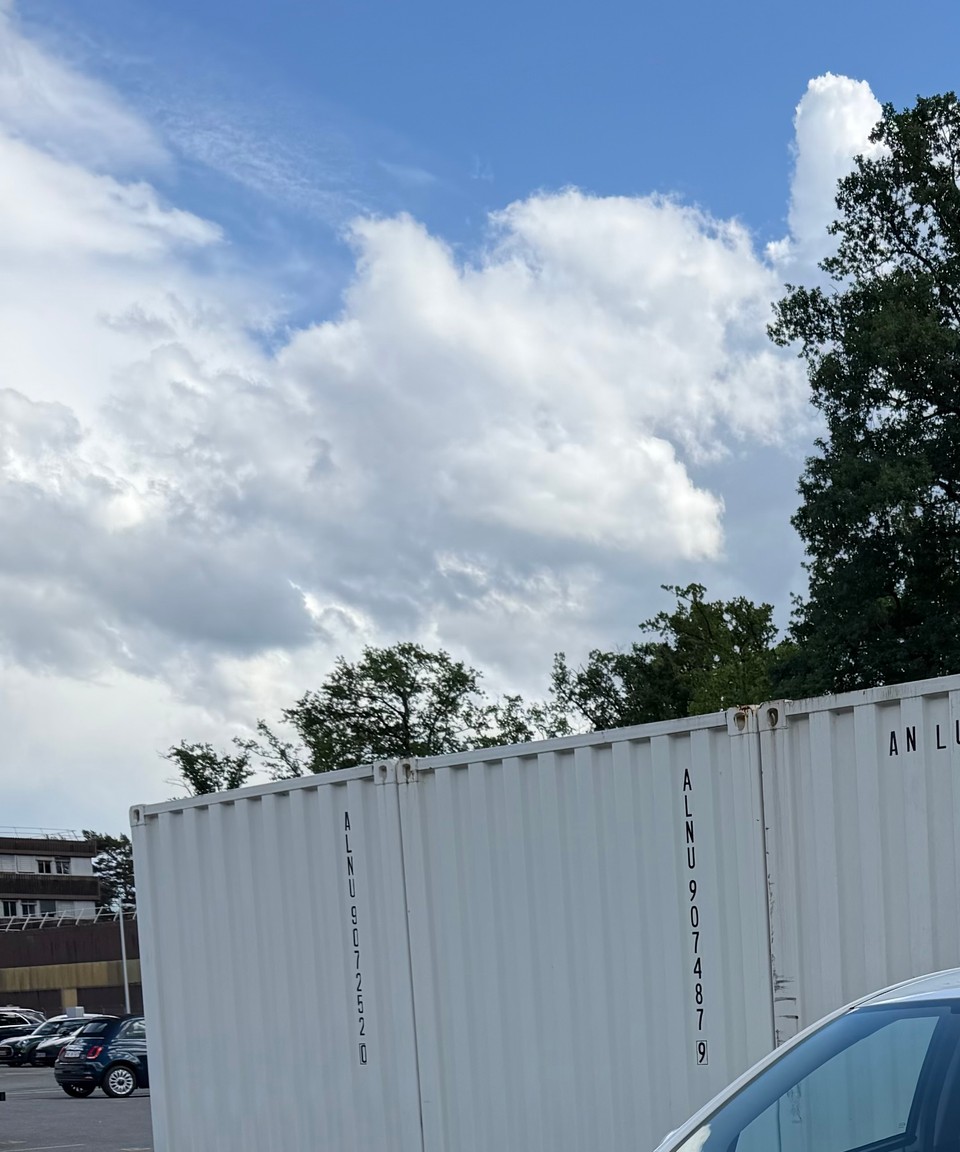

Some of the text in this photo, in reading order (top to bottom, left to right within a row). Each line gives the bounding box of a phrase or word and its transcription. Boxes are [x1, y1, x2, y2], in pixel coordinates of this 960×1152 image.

[682, 768, 696, 870] ALNU
[344, 811, 356, 898] ALNU
[350, 905, 366, 1036] 907252
[688, 879, 704, 1031] 907487
